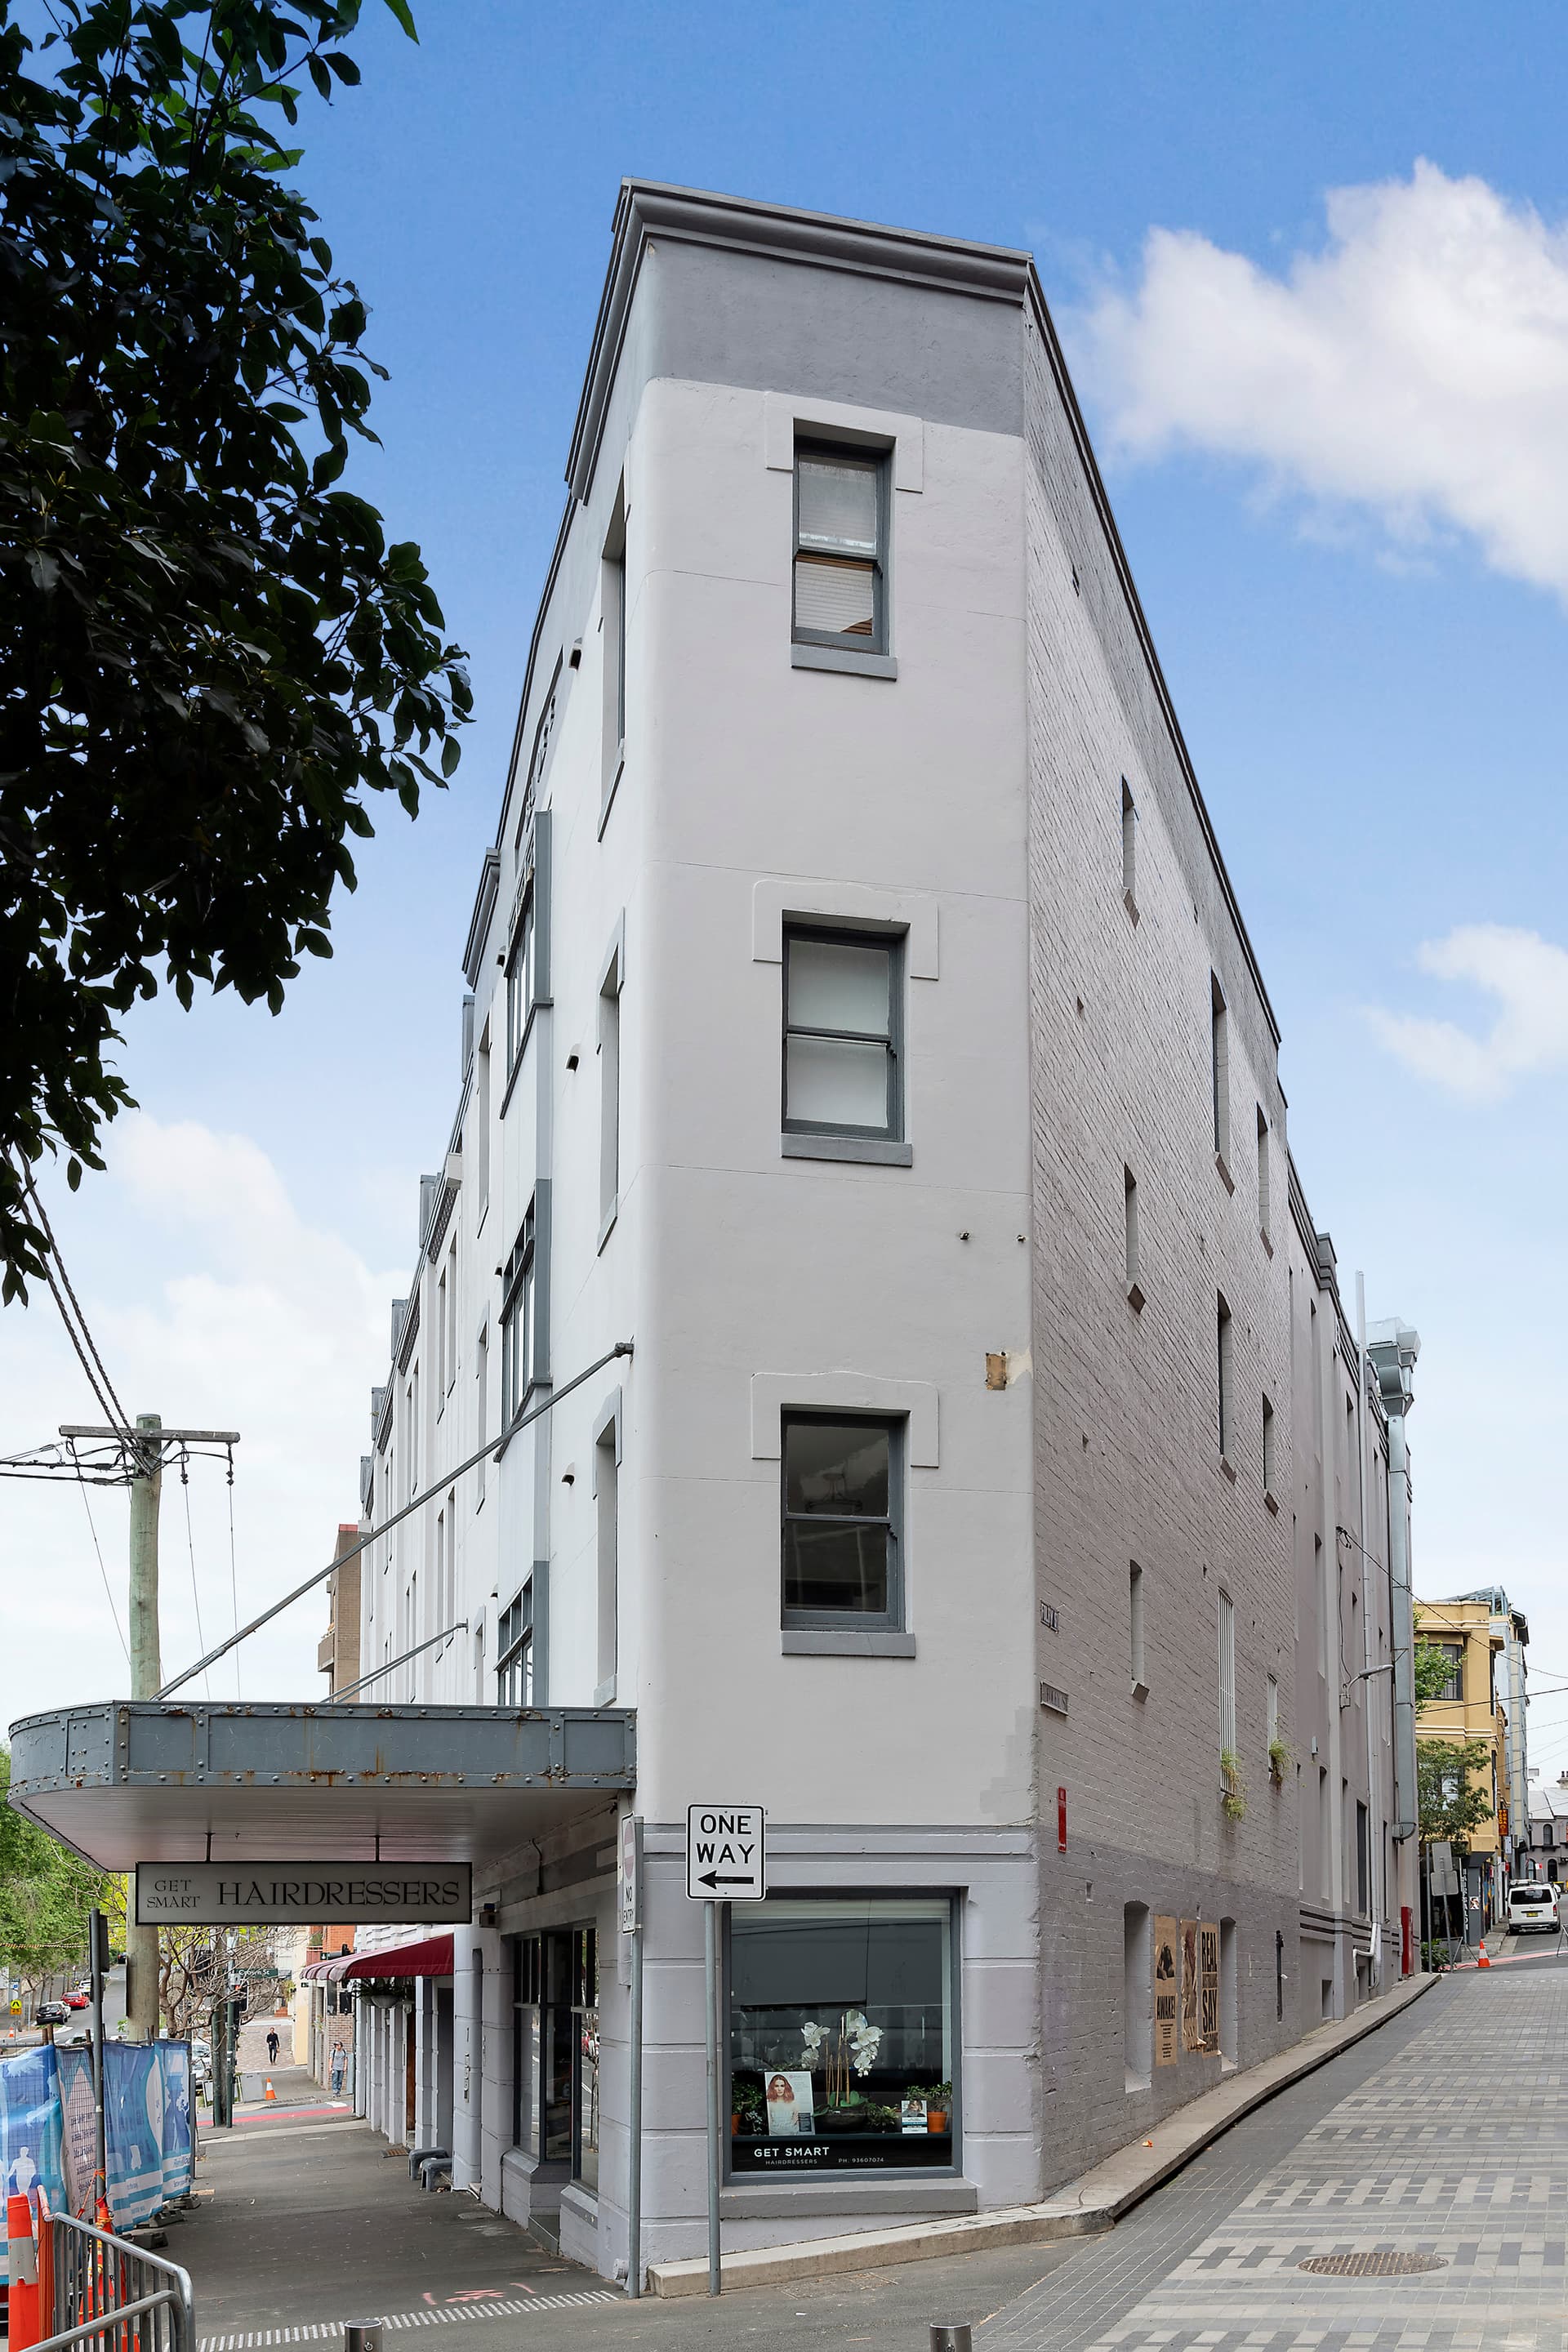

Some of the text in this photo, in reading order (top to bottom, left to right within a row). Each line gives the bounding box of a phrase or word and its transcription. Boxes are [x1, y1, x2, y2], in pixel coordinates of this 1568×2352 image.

[700, 1814, 752, 1834] ONE
[696, 1842, 755, 1864] WAY
[154, 1880, 191, 1892] GET
[216, 1880, 460, 1906] HAIRDRESSERS
[626, 1885, 633, 1903] NO
[146, 1895, 200, 1909] SMART
[623, 1908, 635, 1924] ENTRY
[1201, 1931, 1218, 1972] REAL
[1202, 1989, 1218, 2034] SAY
[754, 2147, 830, 2158] GET SMART
